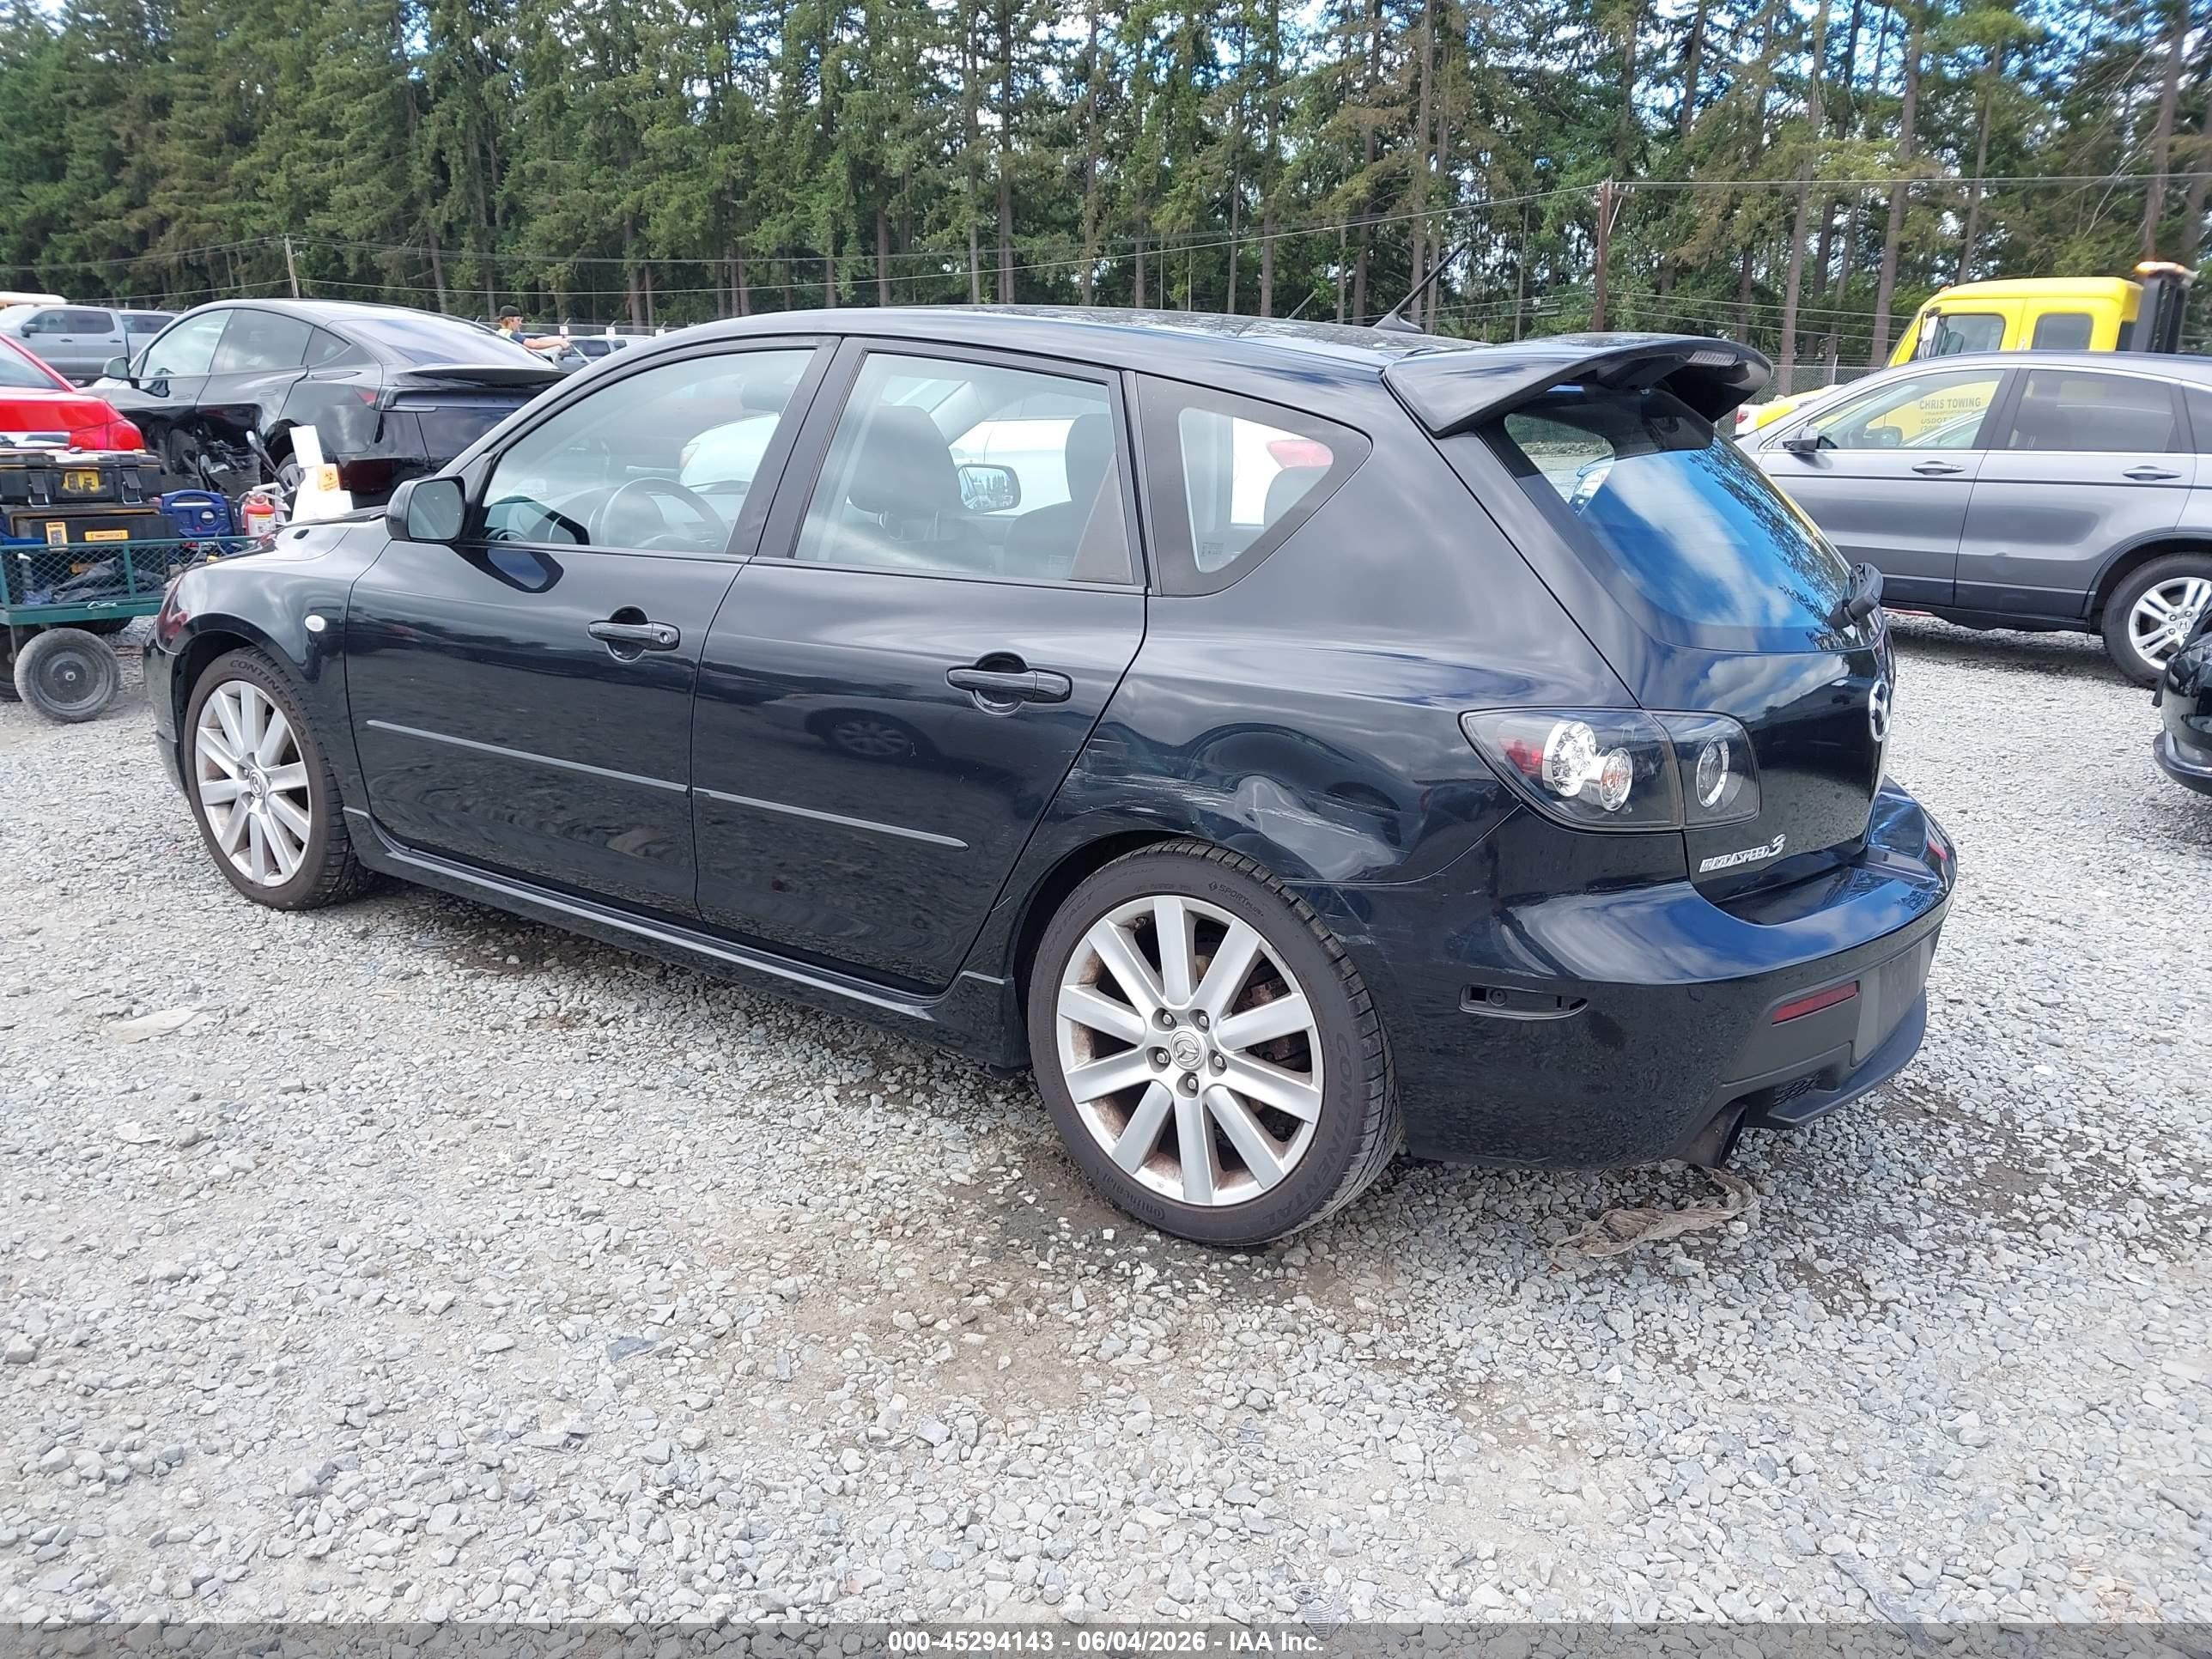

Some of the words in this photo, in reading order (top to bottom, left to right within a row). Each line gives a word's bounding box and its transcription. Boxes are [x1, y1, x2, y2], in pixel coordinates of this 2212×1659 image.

[1919, 399, 1945, 410] CHRIS
[1948, 398, 1981, 409] TOWING
[229, 659, 311, 747] CONTINENTAL
[1261, 1031, 1353, 1225] CONTINENTAL
